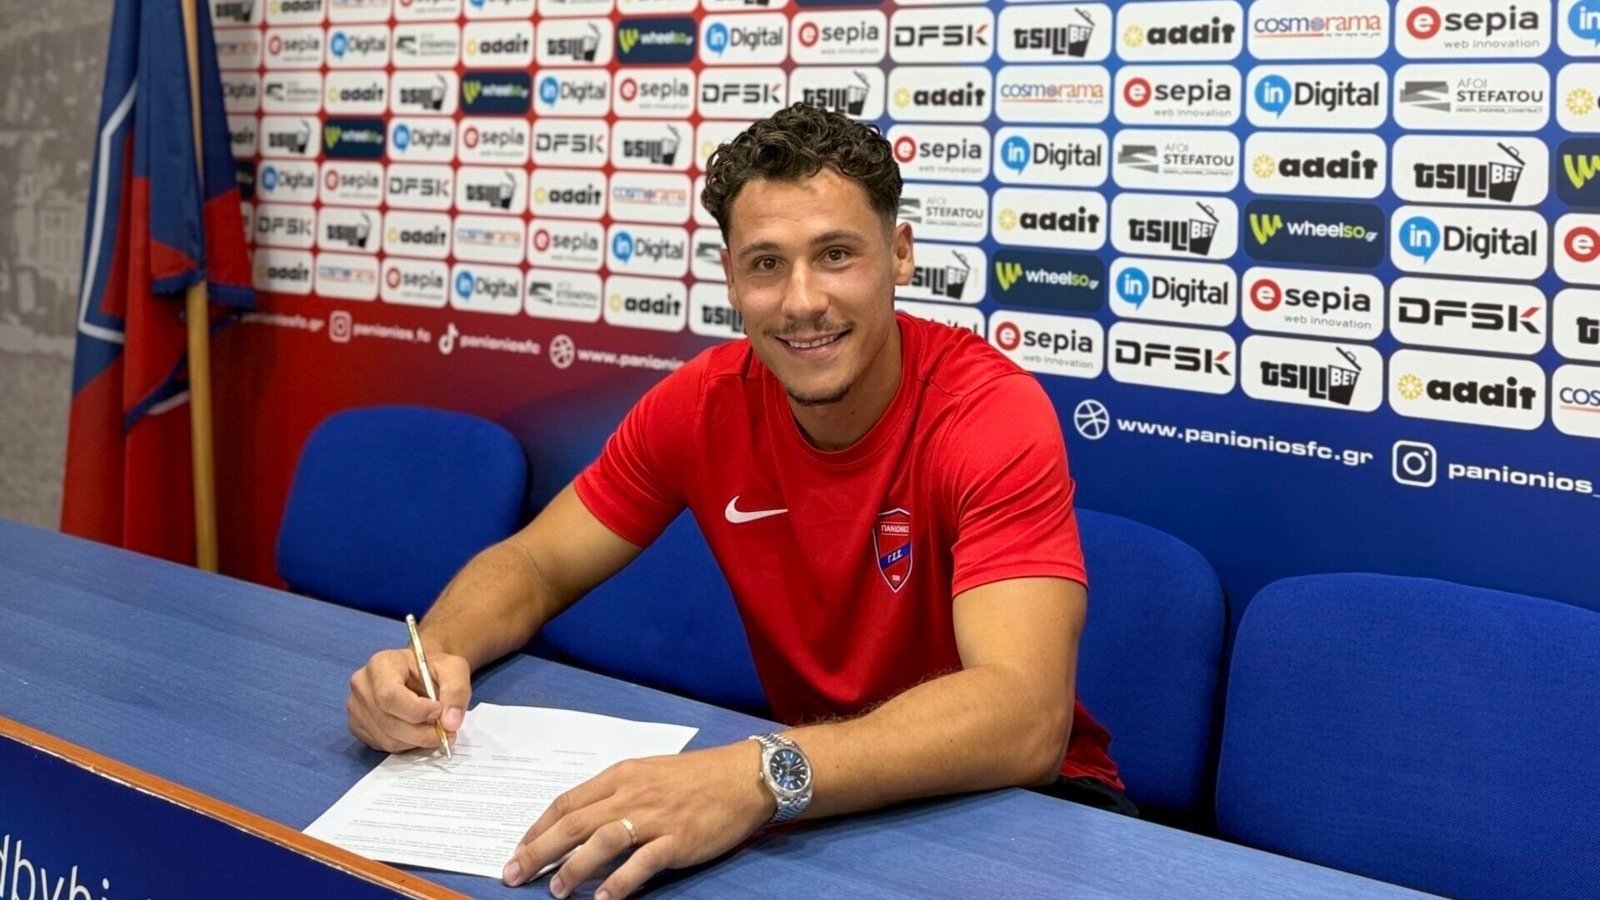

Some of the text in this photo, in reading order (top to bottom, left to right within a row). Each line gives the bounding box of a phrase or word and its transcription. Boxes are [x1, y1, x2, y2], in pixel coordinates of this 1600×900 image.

[1148, 17, 1235, 44] addit
[1255, 14, 1381, 32] cosmorama
[894, 25, 988, 47] DFSK
[1444, 38, 1539, 48] web innovation
[702, 84, 780, 103] DFSK
[914, 83, 985, 106] addit
[1001, 82, 1103, 98] cosmorama
[1457, 90, 1543, 102] STEFATOU
[1154, 109, 1231, 117] web innovation
[536, 135, 604, 153] DFSK
[1163, 153, 1234, 167] STEFATOU
[1279, 150, 1377, 180] addit
[390, 178, 450, 196] DFSK
[548, 184, 601, 206] addit
[926, 207, 983, 220] STEFATOU
[1020, 207, 1099, 233] addit
[625, 294, 680, 316] addit
[1285, 315, 1371, 330] web innovation
[1399, 297, 1541, 334] DFSK
[1045, 356, 1093, 369] innovation
[1116, 340, 1232, 376] DFSK
[1427, 377, 1535, 410] addit
[1116, 417, 1373, 467] www.panioniosfc.gr
